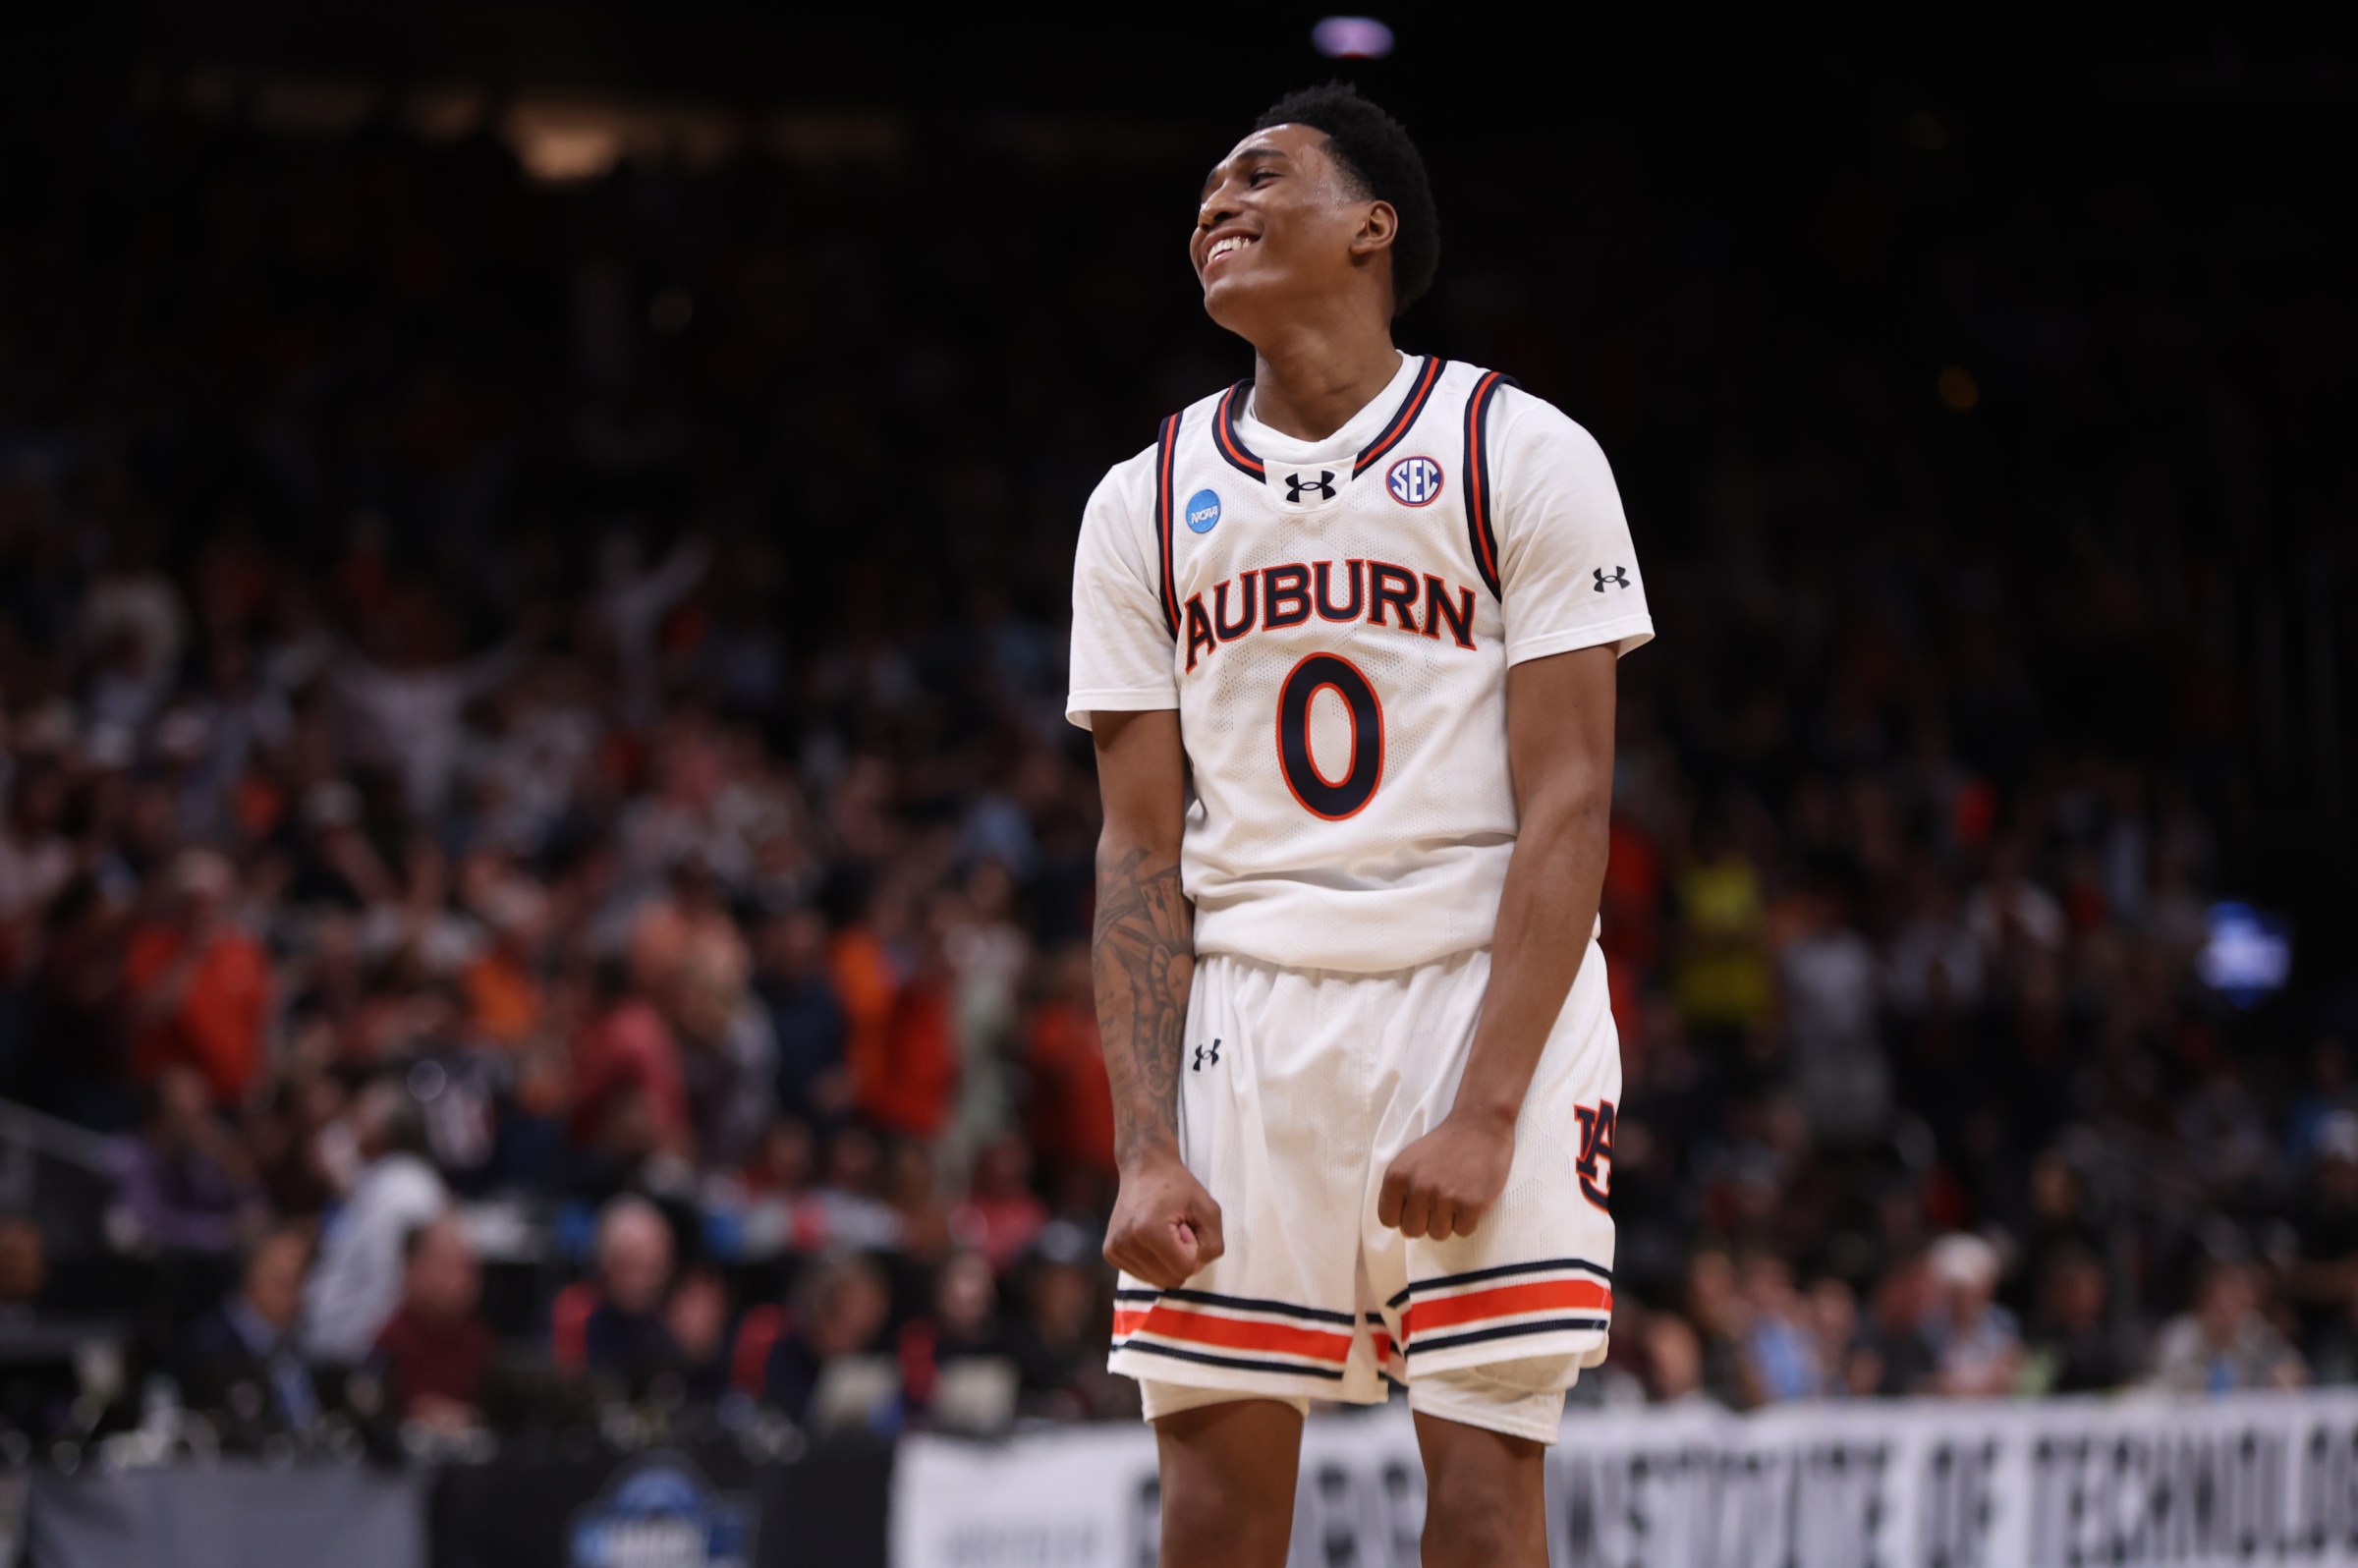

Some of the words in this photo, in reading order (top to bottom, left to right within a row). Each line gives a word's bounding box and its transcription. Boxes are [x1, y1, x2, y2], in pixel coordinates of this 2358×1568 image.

[1191, 505, 1218, 525] NCAA
[1390, 459, 1439, 502] SEC
[1185, 558, 1478, 674] AUBURN
[1276, 651, 1385, 822] 0
[1547, 1444, 1890, 1568] NSTITUTE
